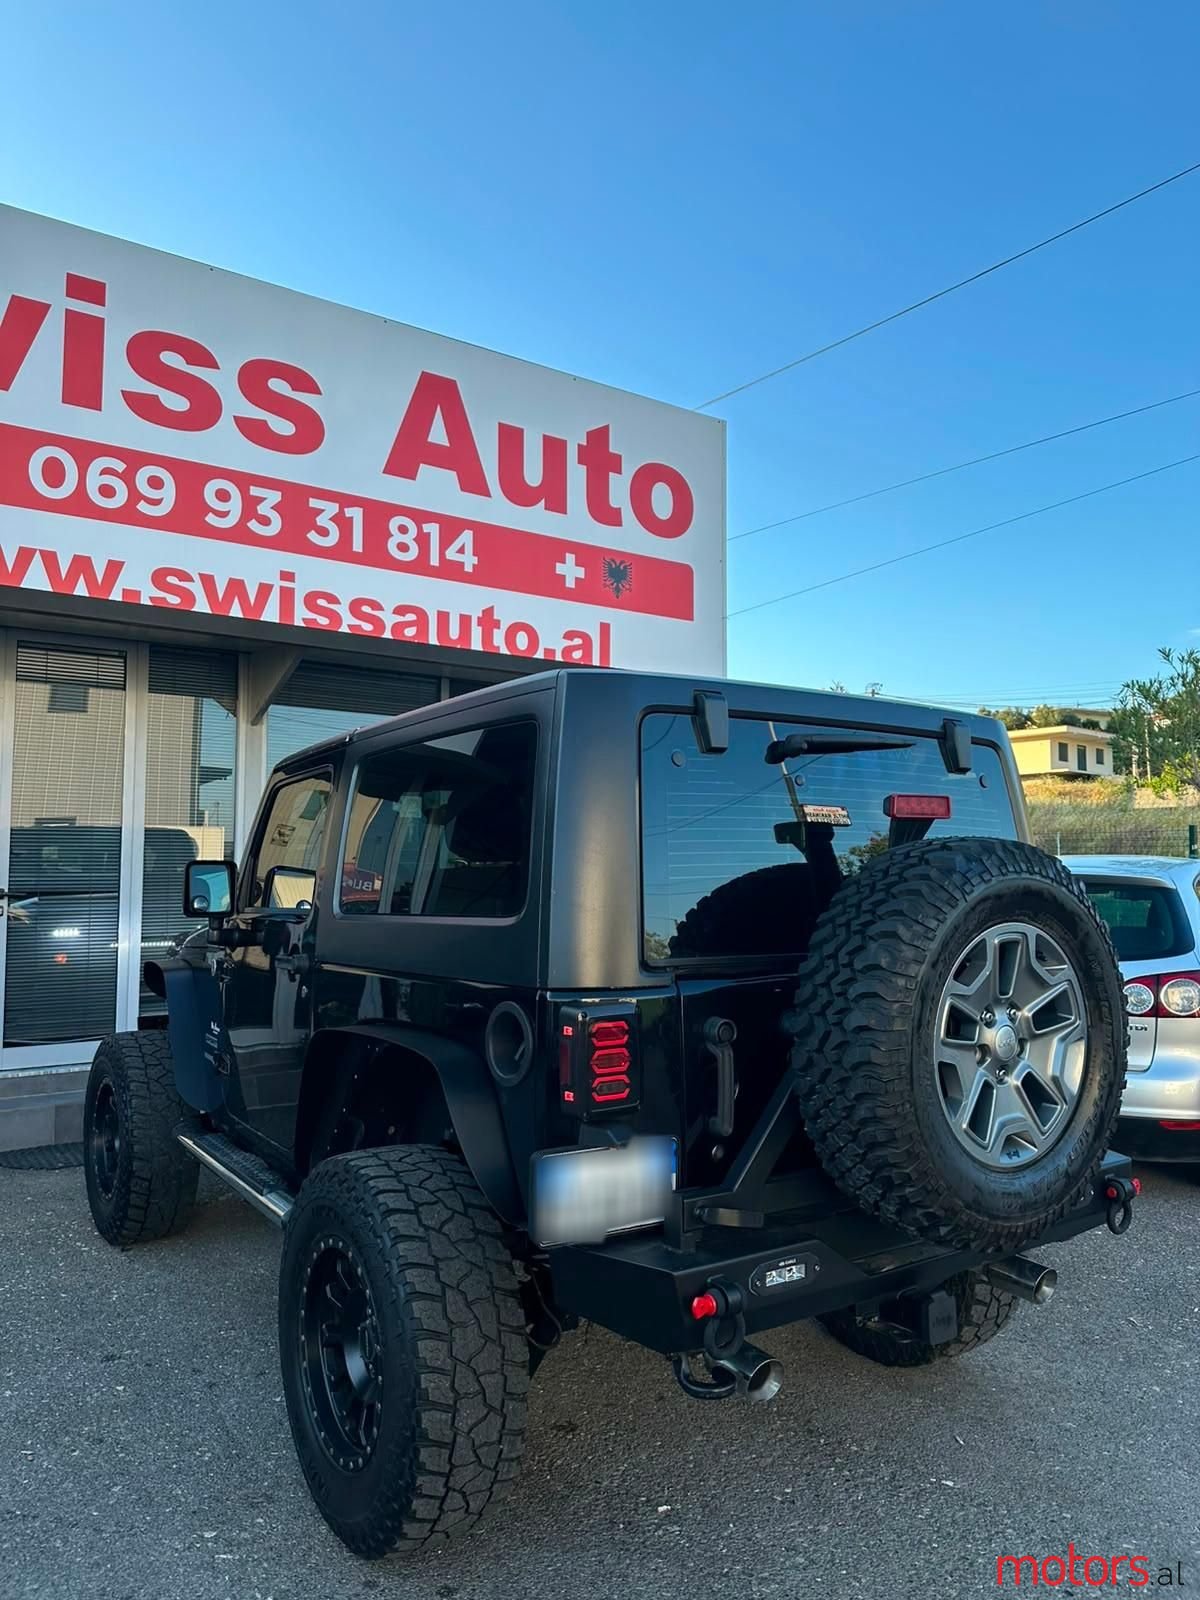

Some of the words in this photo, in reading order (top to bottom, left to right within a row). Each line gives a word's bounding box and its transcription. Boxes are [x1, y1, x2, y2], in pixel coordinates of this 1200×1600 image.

[27, 444, 177, 518] 069
[203, 477, 284, 538] 93
[306, 496, 365, 554] 31
[386, 515, 479, 574] 814
[382, 370, 694, 539] Auto
